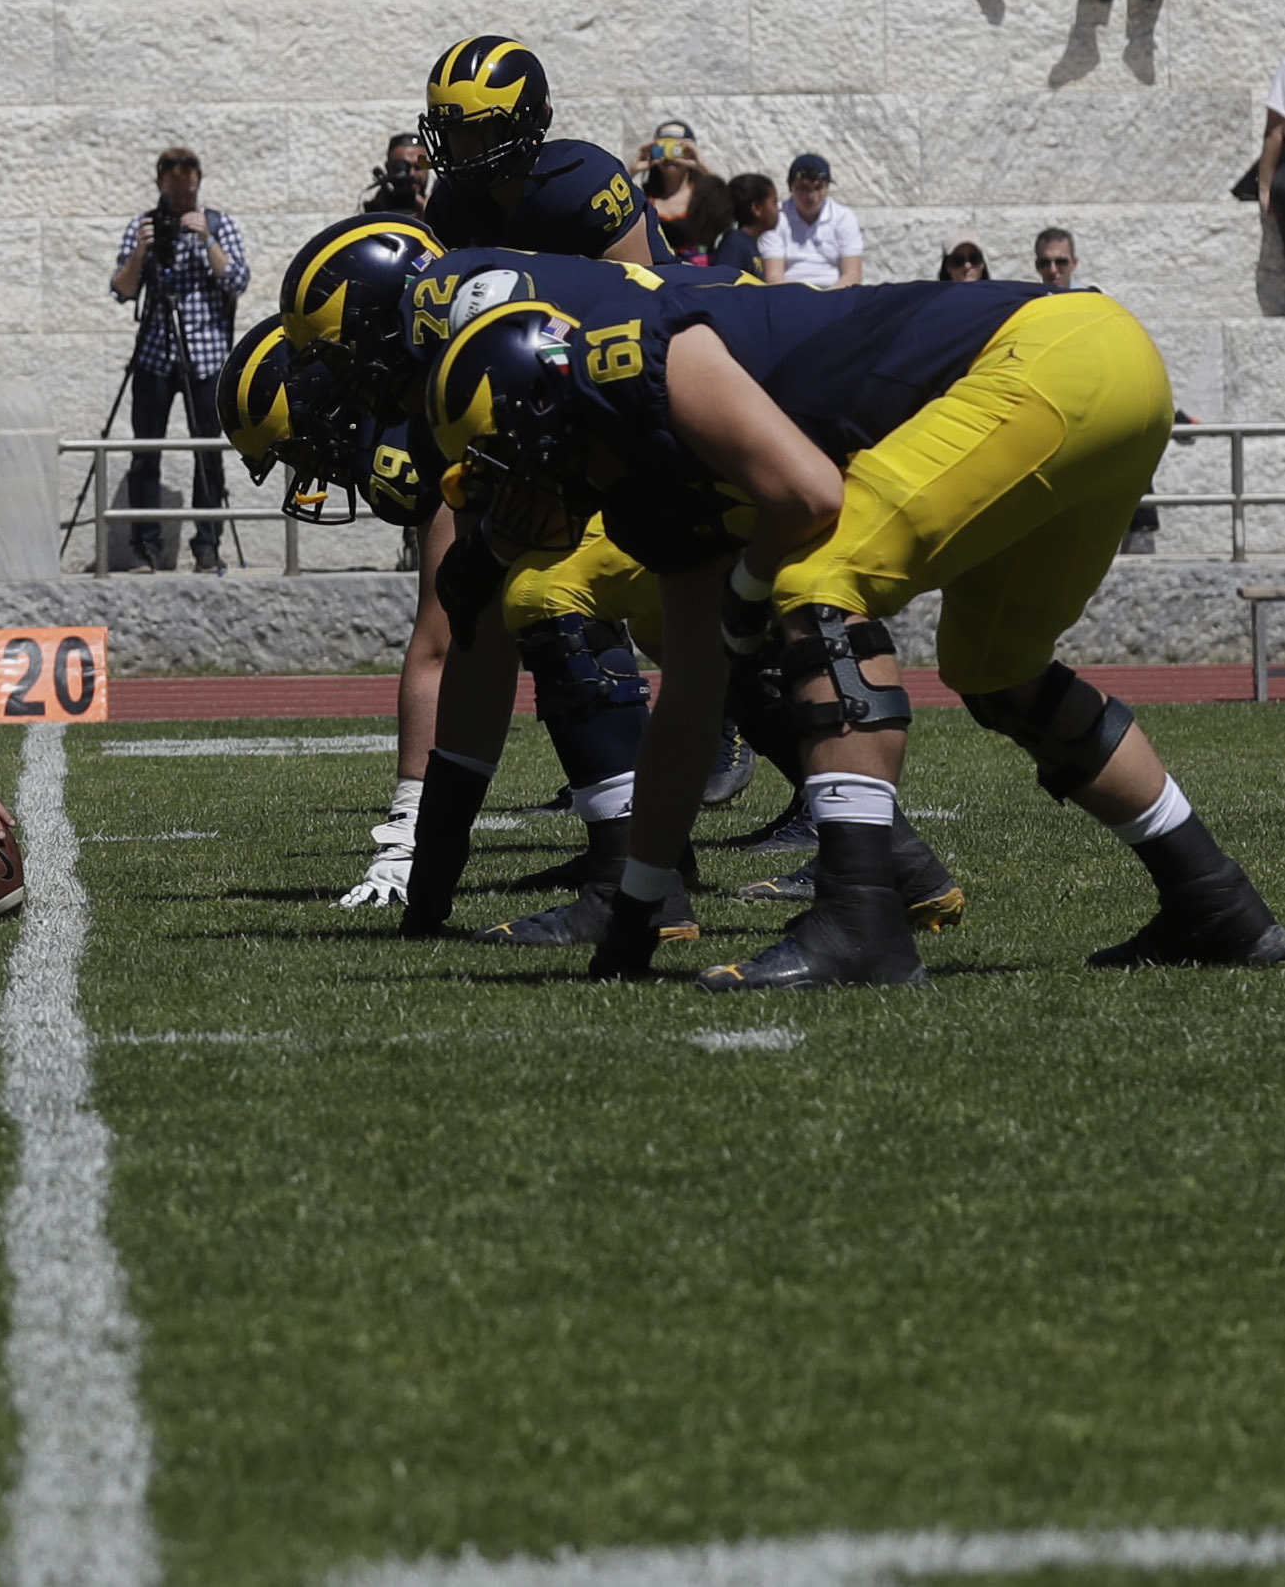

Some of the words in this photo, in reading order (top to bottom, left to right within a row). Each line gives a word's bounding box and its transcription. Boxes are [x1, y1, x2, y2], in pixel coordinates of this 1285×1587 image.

[591, 173, 634, 231] 39
[412, 274, 460, 345] 72
[585, 318, 644, 384] 61
[3, 636, 96, 717] 20
